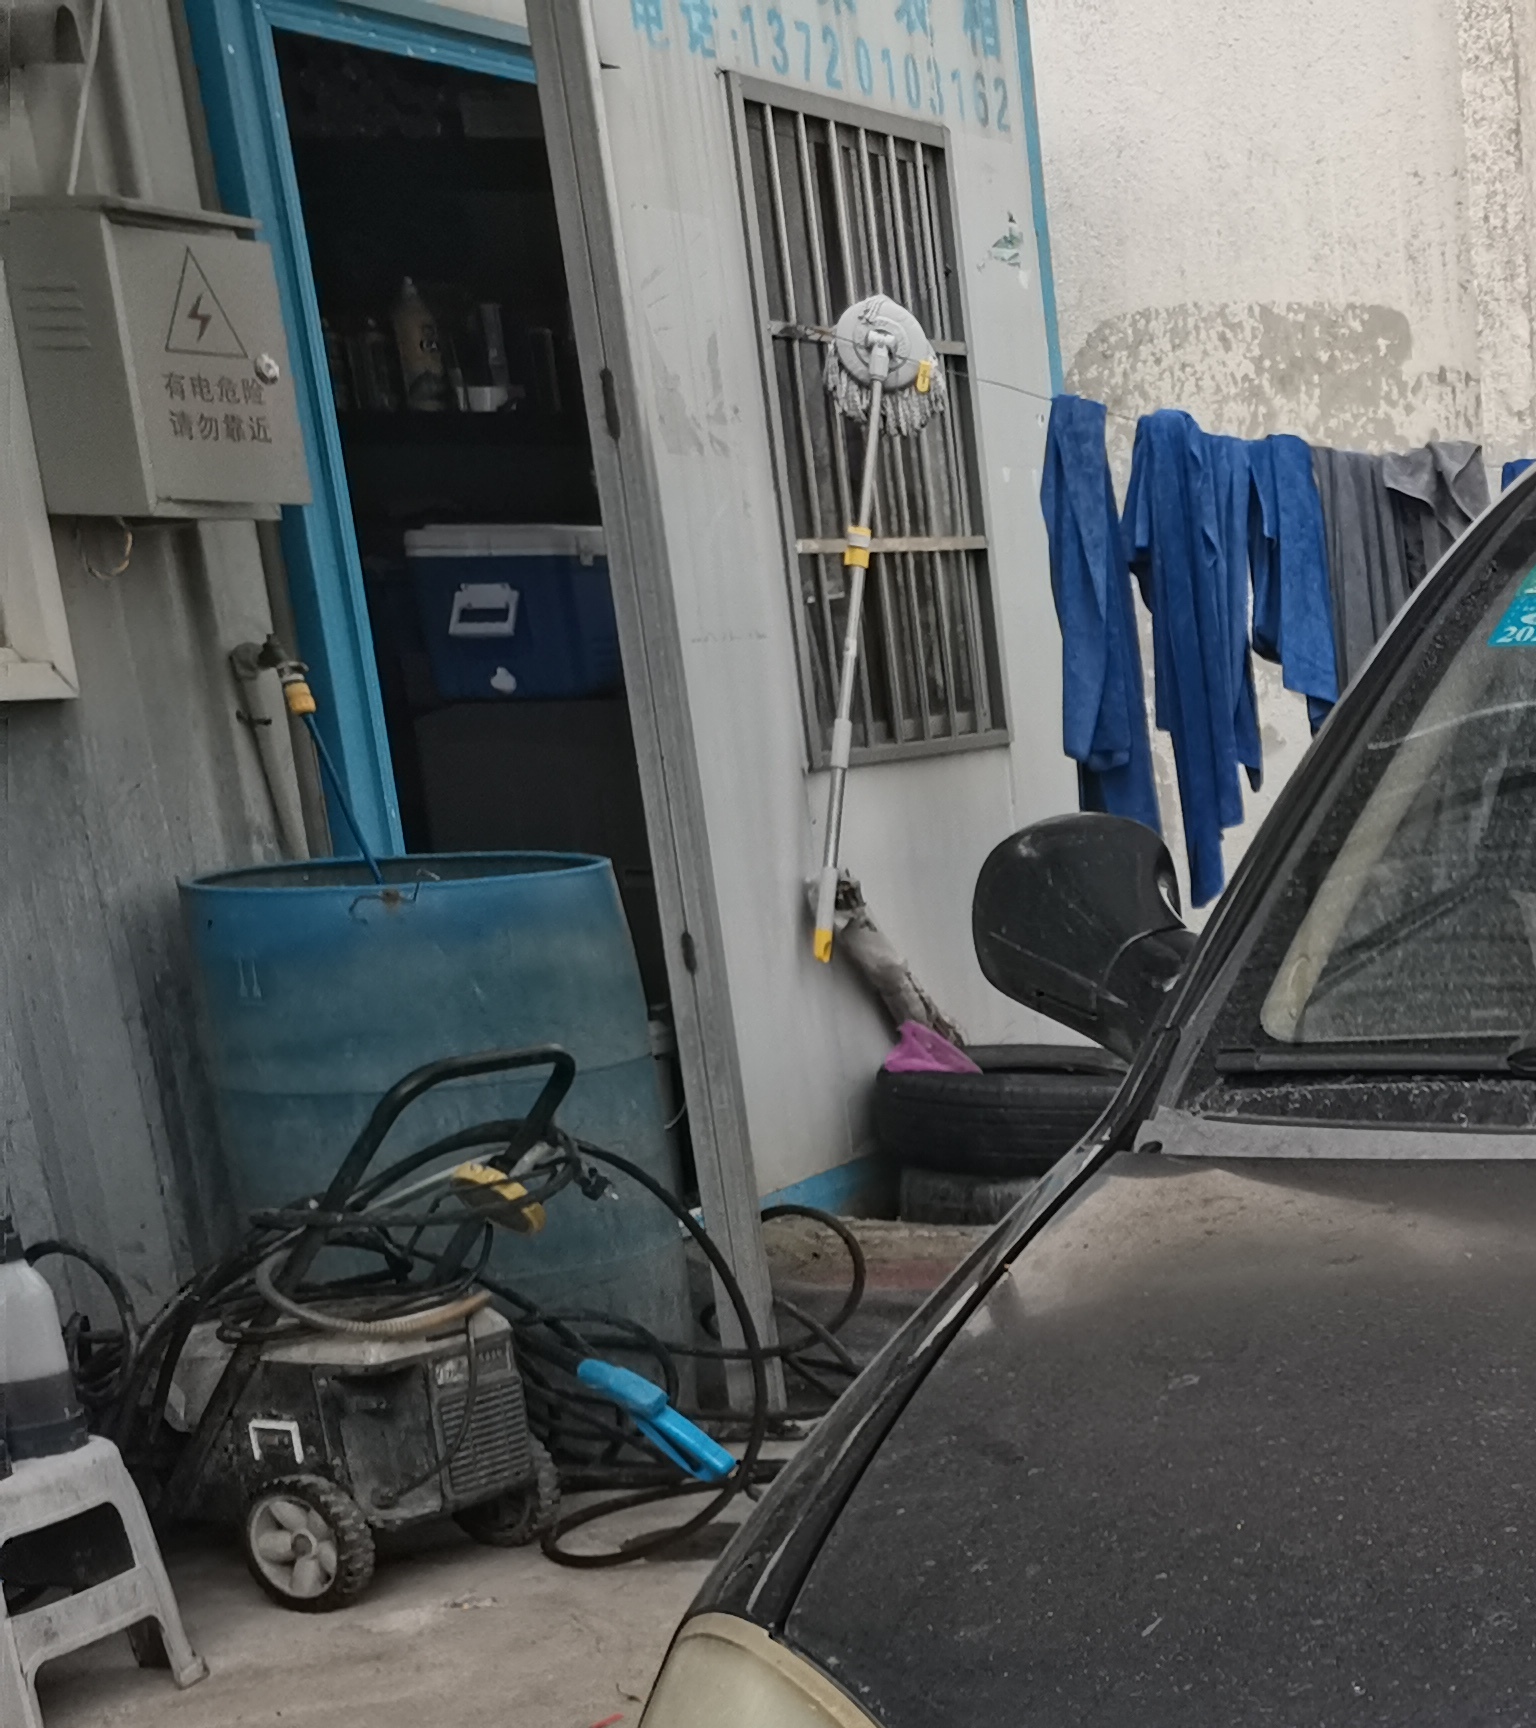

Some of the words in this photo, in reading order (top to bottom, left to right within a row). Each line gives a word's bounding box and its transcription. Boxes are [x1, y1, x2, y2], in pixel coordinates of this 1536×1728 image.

[162, 371, 266, 404] 有电危险
[168, 409, 273, 443] 请勿靠近
